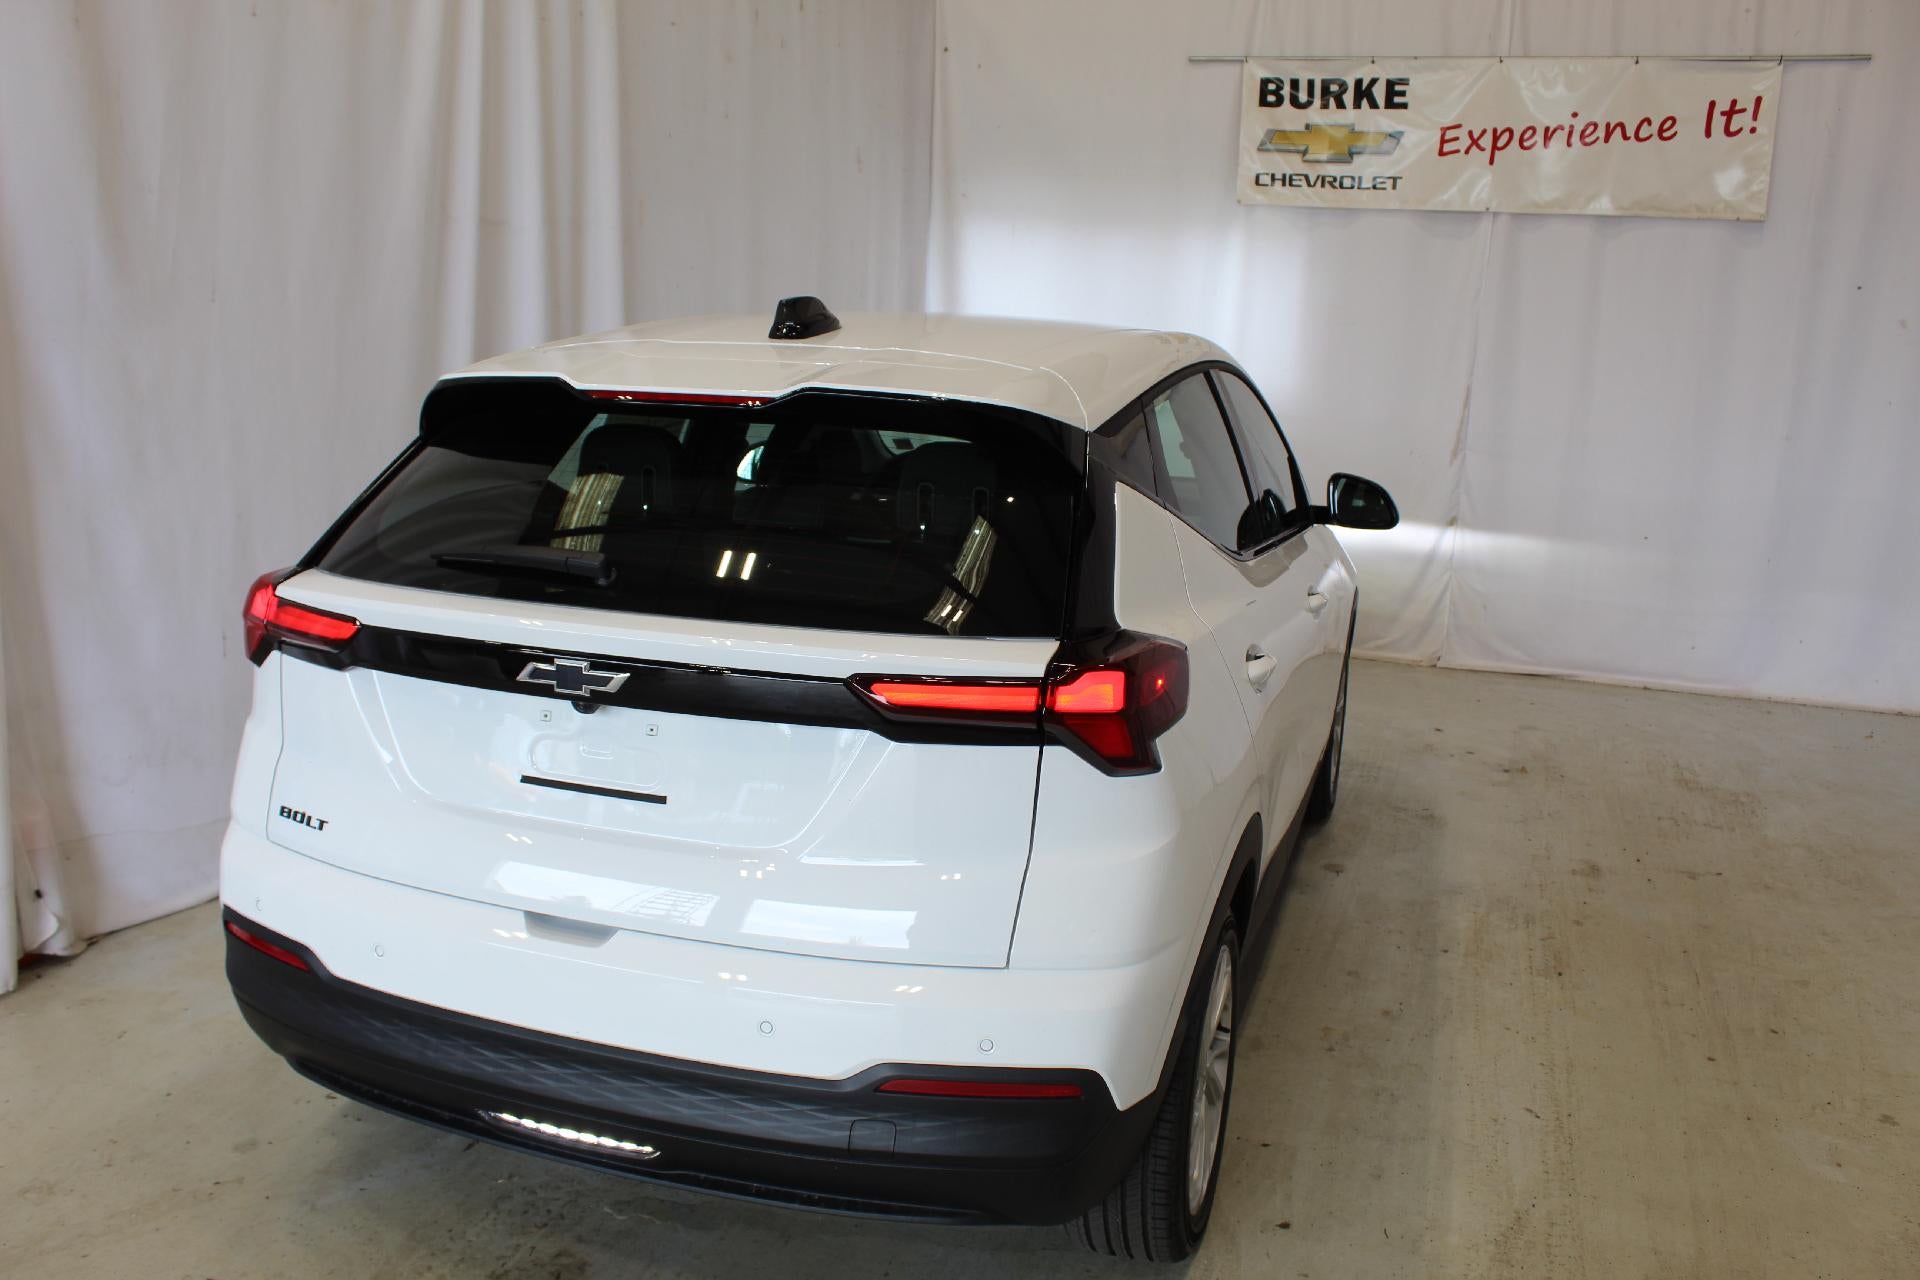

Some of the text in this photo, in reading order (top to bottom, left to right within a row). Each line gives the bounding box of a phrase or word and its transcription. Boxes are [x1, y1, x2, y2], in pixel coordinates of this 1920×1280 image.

[1258, 77, 1410, 110] BURKE
[1438, 96, 1763, 165] Experience It!
[1254, 172, 1403, 190] CHEVROLET
[280, 805, 329, 831] BOLT
